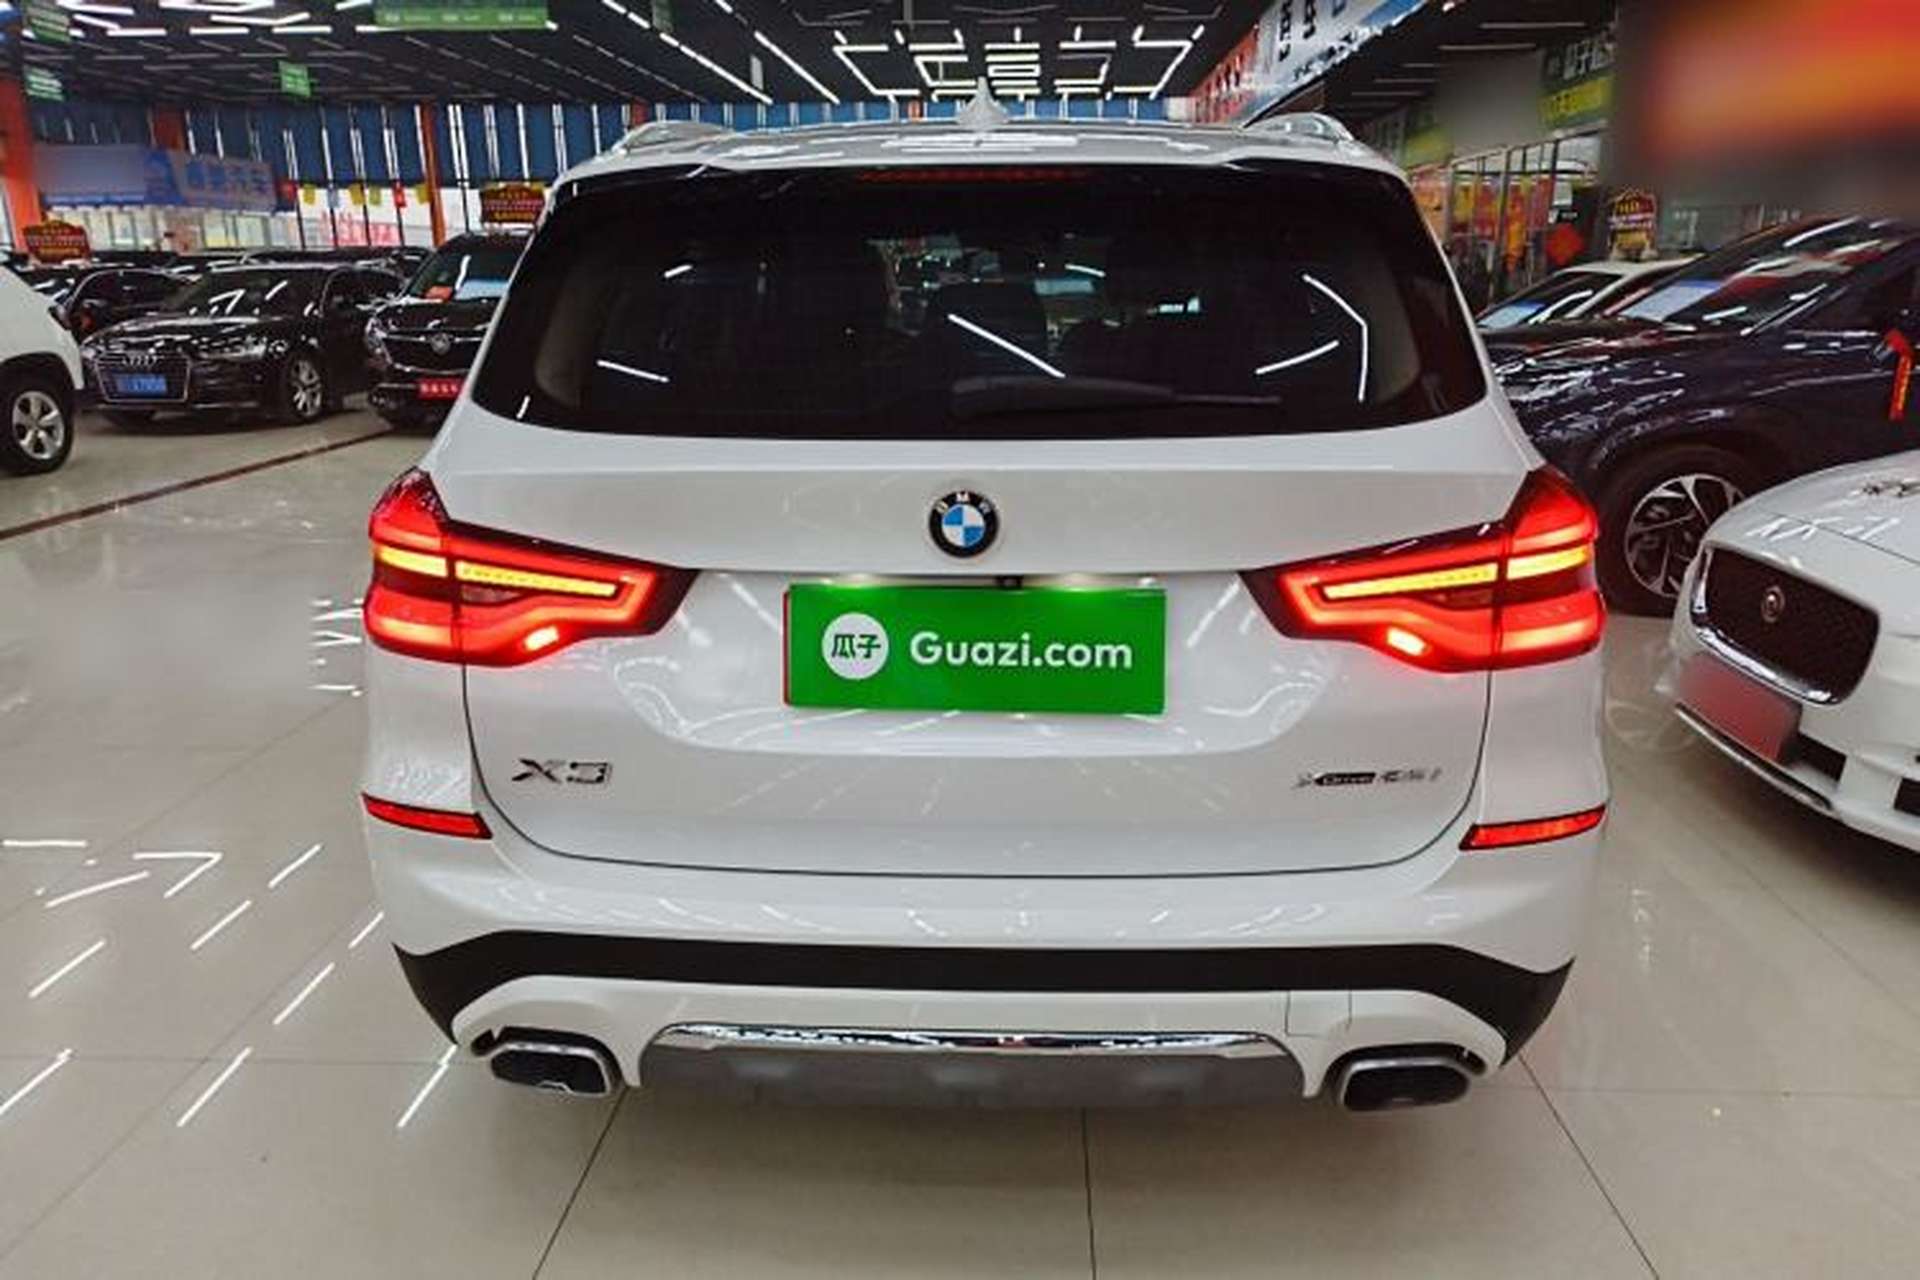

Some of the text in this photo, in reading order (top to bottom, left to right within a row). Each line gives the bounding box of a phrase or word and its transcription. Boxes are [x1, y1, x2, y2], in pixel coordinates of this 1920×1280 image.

[831, 633, 882, 660] 瓜子
[909, 630, 1134, 670] Guazi.com
[511, 758, 613, 784] X3
